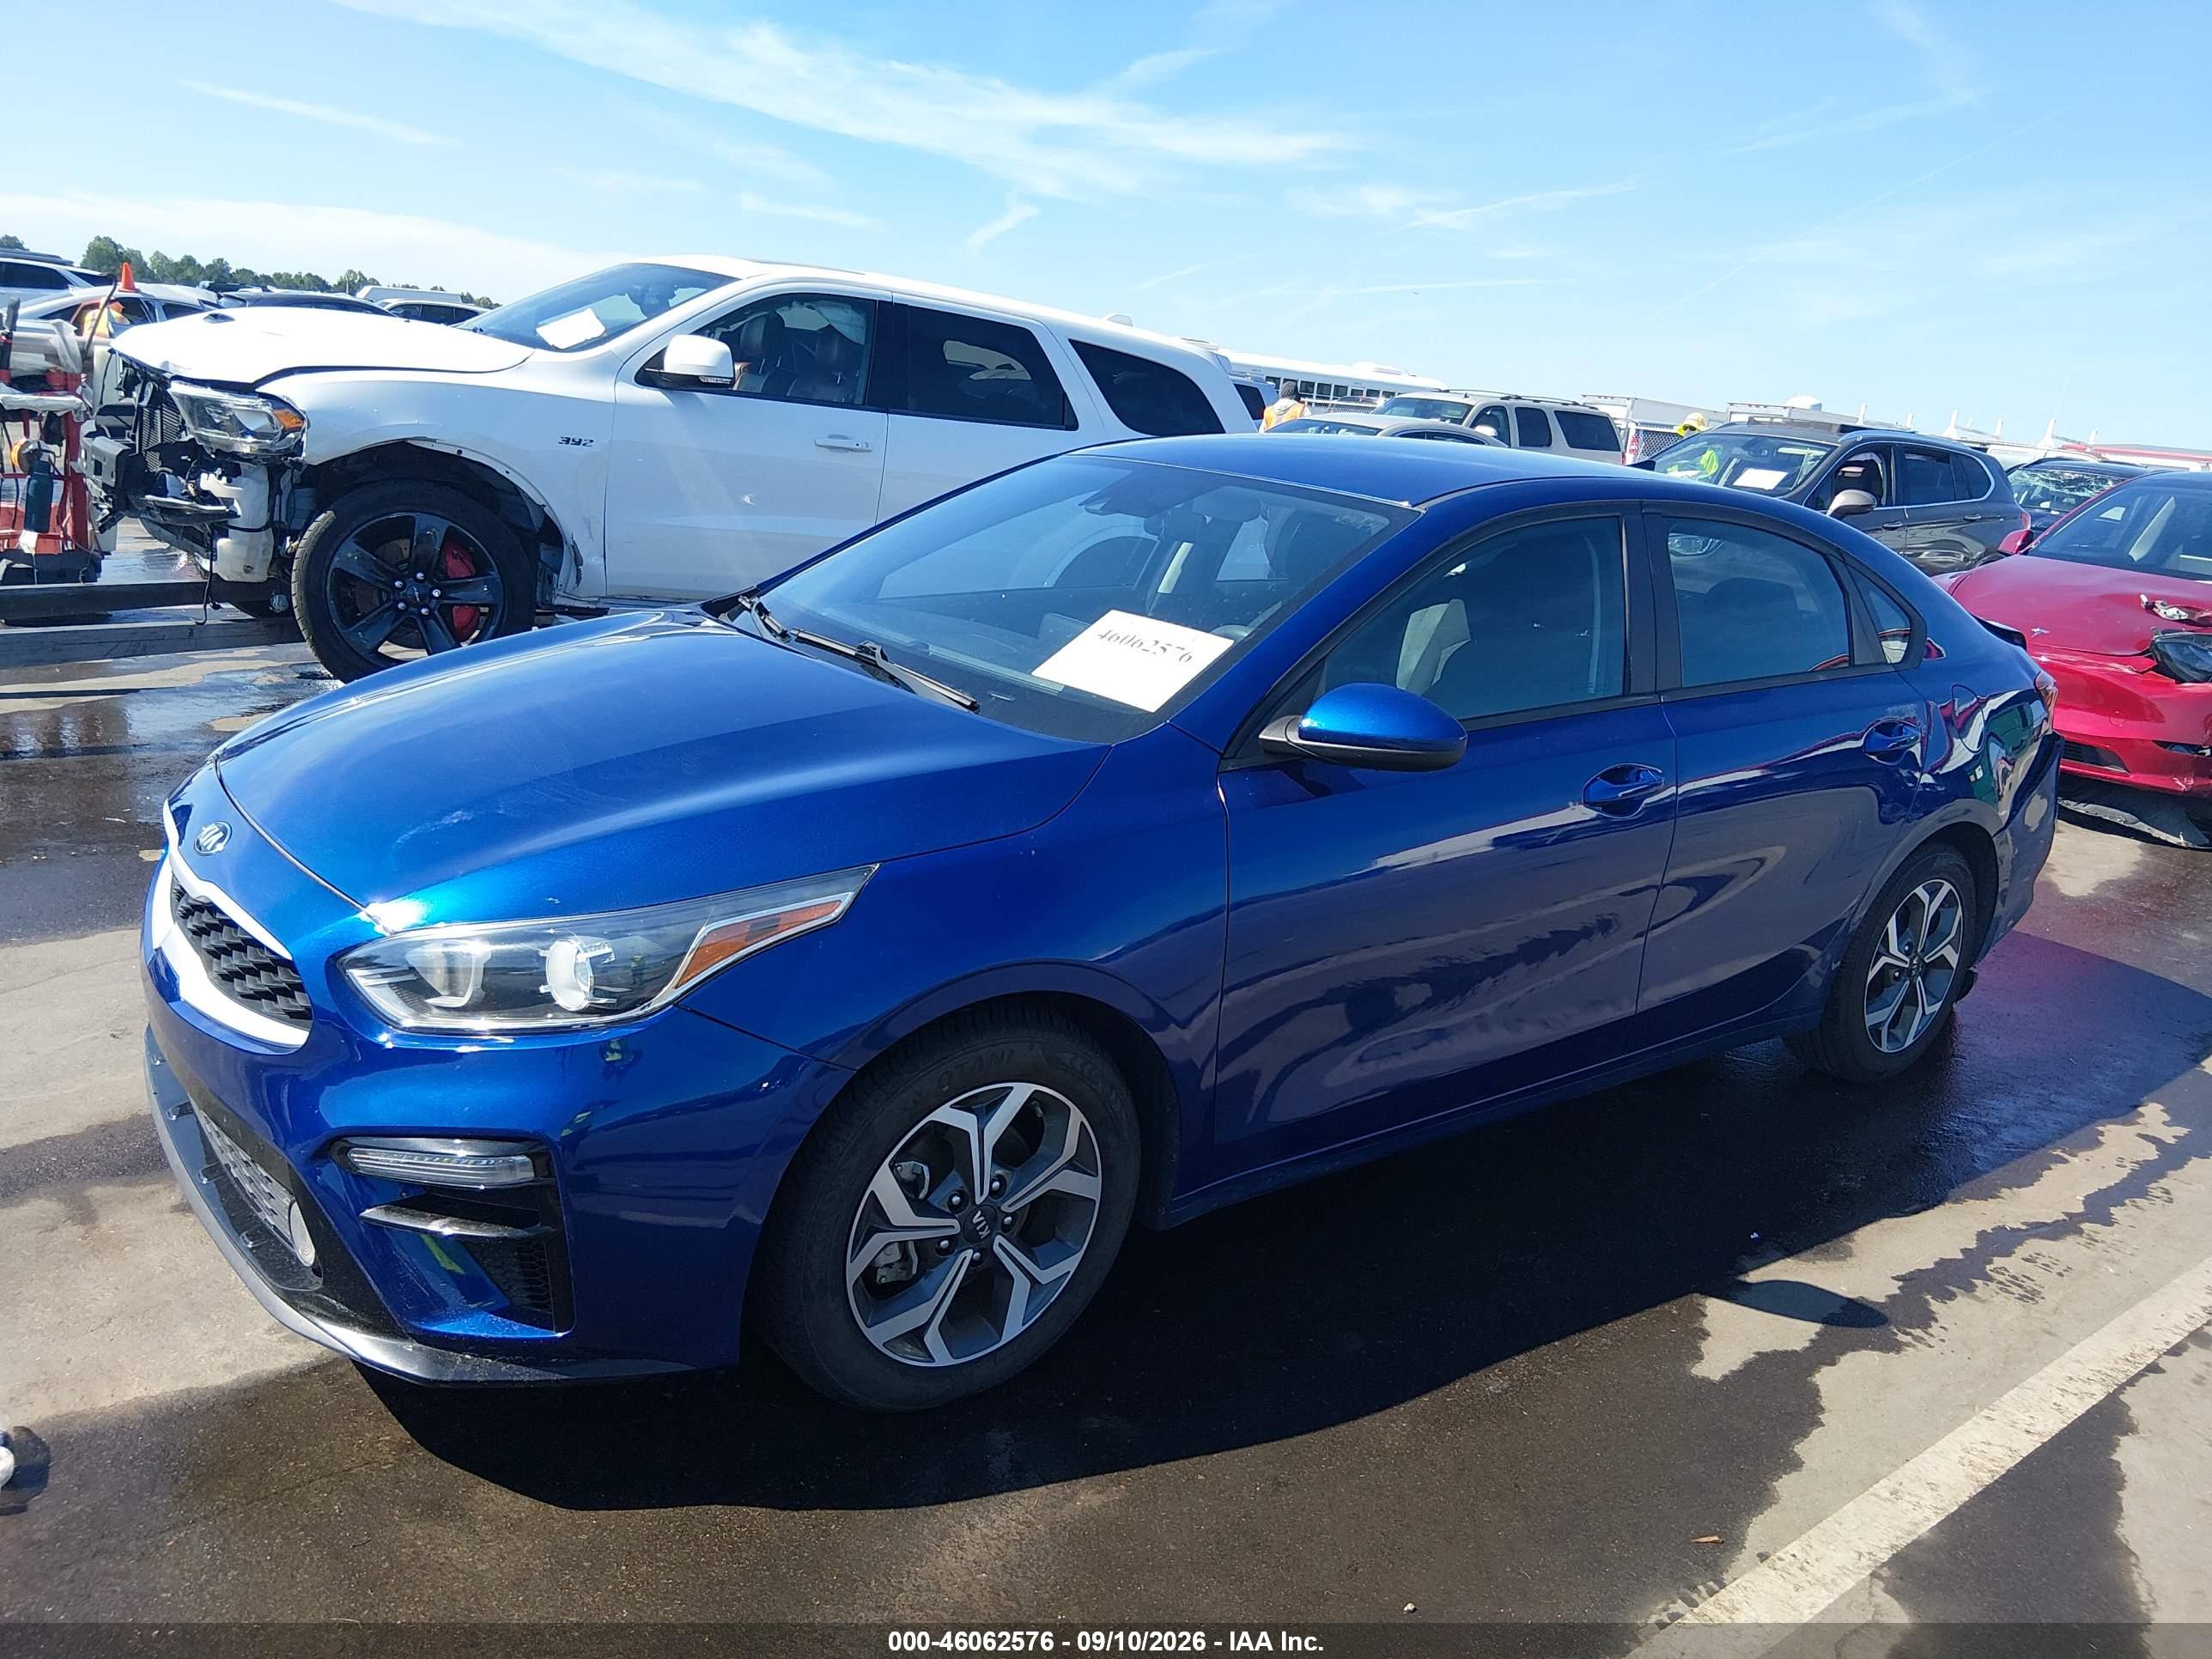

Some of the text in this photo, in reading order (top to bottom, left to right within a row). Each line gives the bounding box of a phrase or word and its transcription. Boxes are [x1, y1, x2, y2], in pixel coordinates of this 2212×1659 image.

[558, 435, 594, 447] 392
[197, 822, 226, 853] KIA
[972, 1209, 992, 1240] KIA
